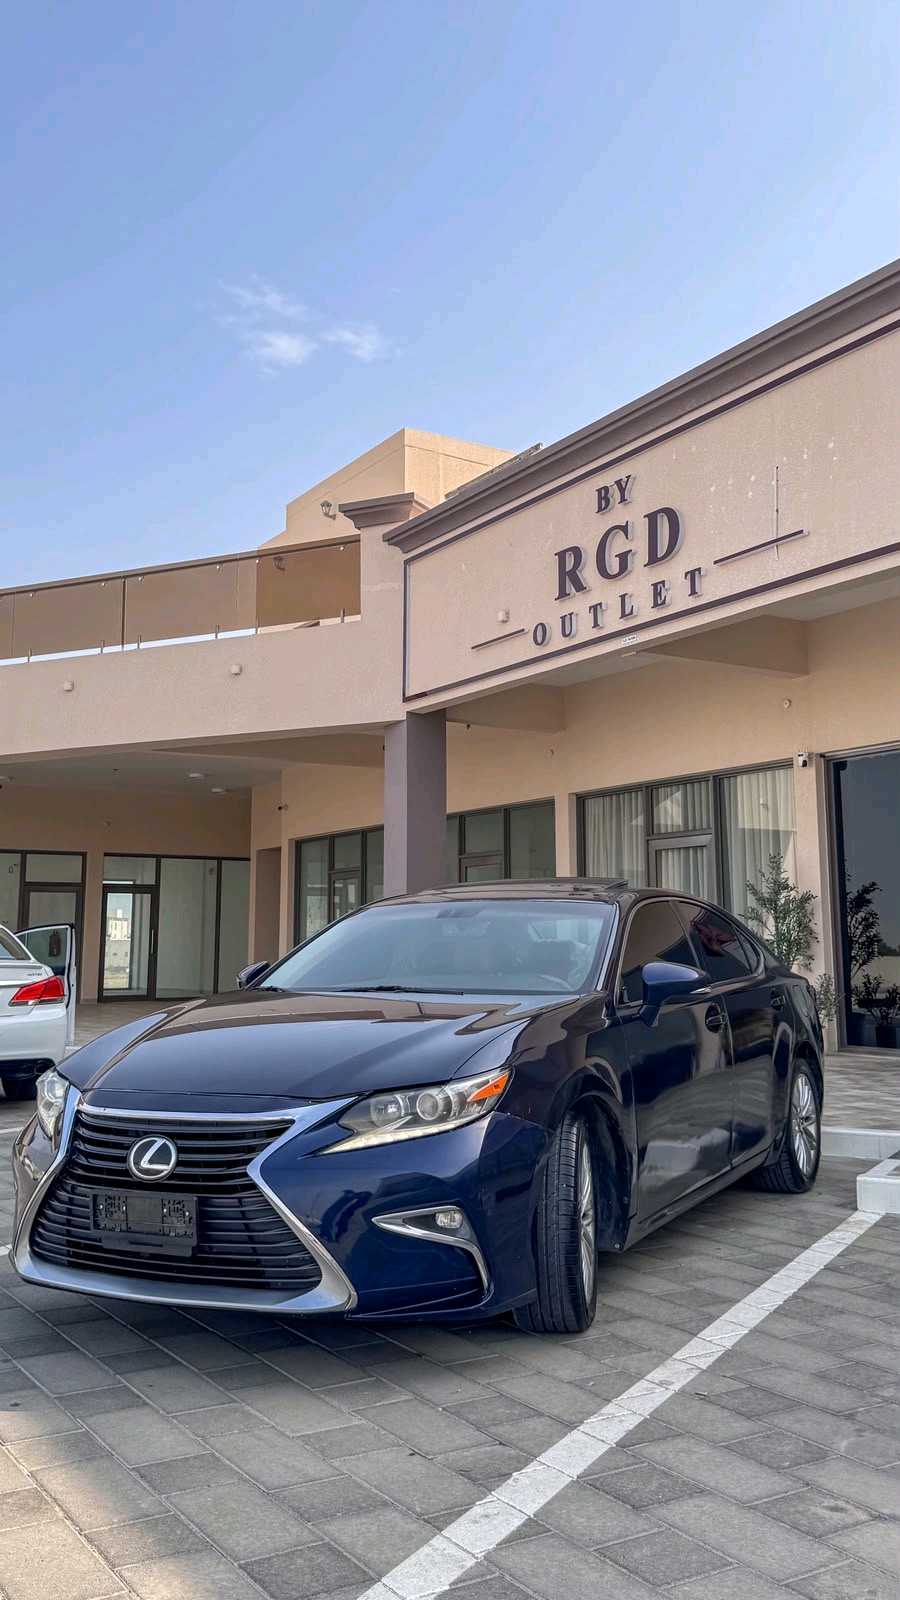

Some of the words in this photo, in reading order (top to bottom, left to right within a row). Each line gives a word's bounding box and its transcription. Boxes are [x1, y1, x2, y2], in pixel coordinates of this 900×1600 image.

[595, 475, 632, 513] BY
[554, 507, 681, 601] RGD
[532, 566, 704, 646] OUTLET
